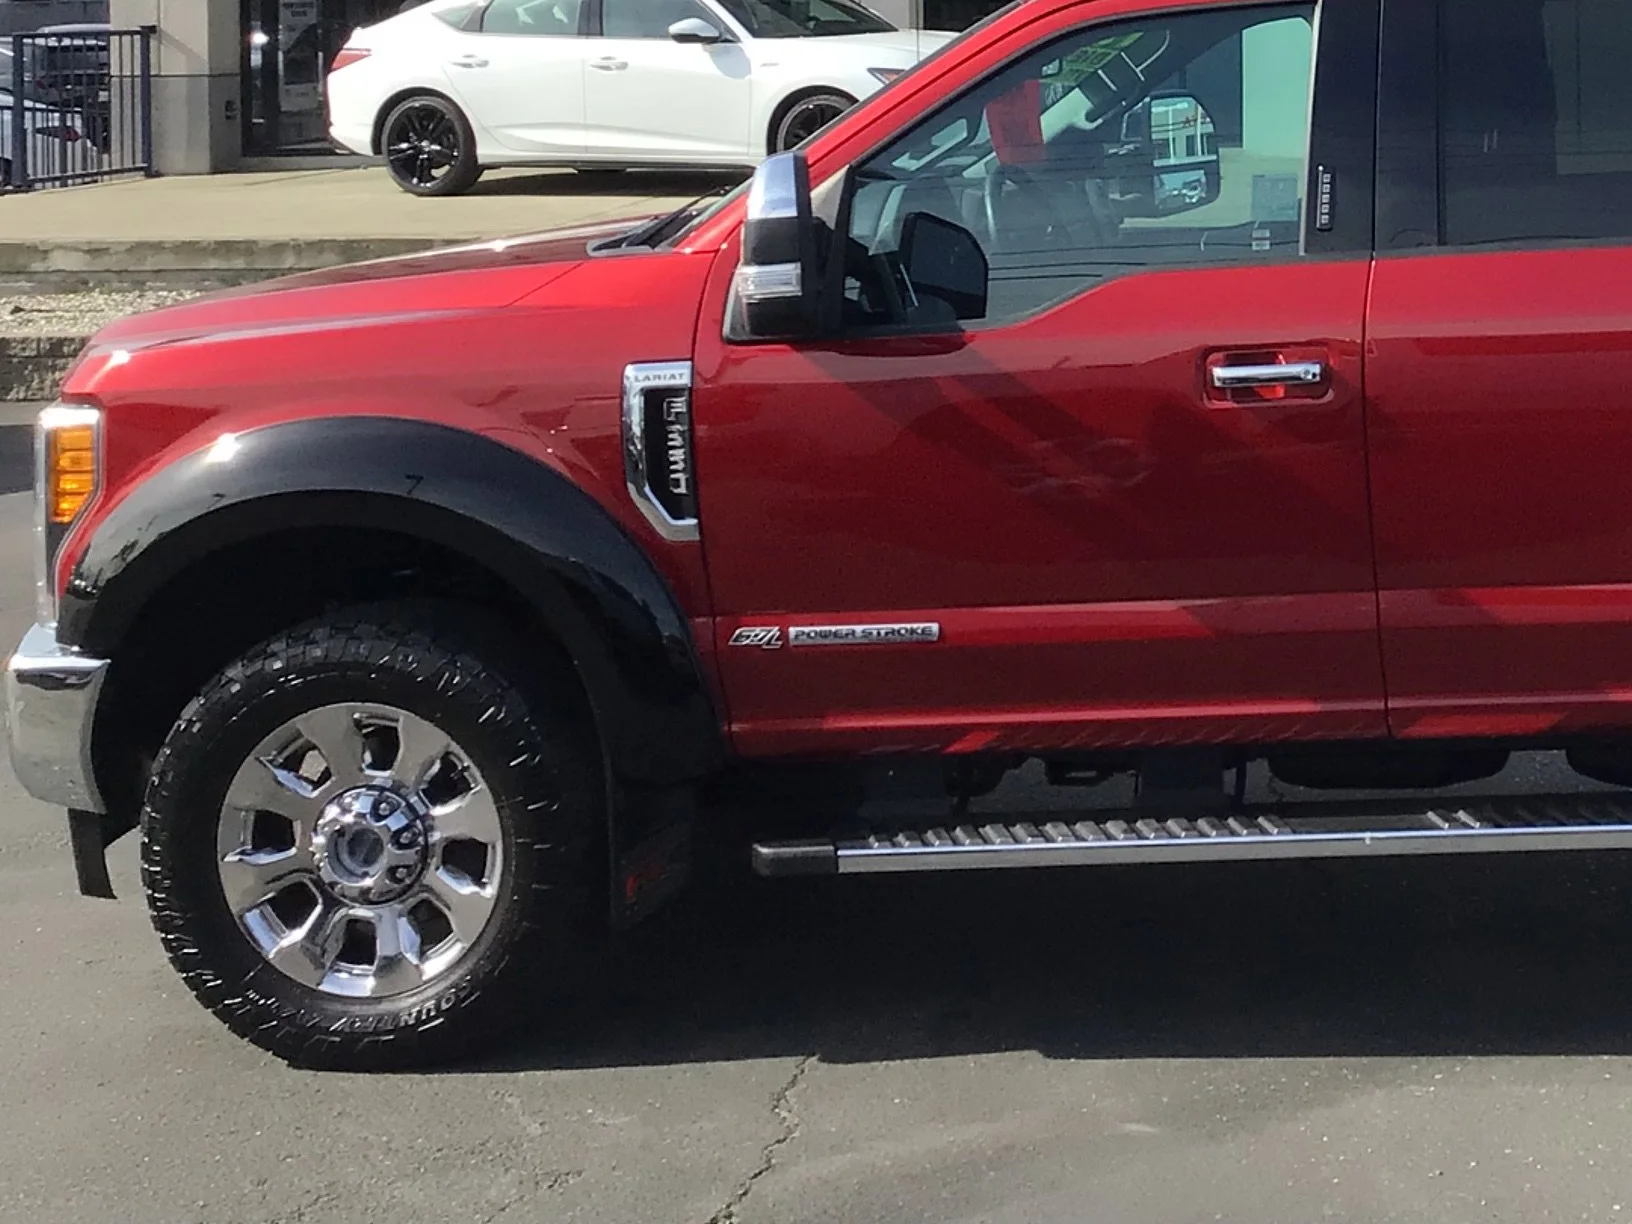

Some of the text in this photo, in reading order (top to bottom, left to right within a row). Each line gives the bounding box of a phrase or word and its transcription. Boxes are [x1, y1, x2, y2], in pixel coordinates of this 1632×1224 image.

[634, 373, 685, 383] LARIAT
[794, 629, 856, 641] POWER
[861, 626, 933, 638] STROKE
